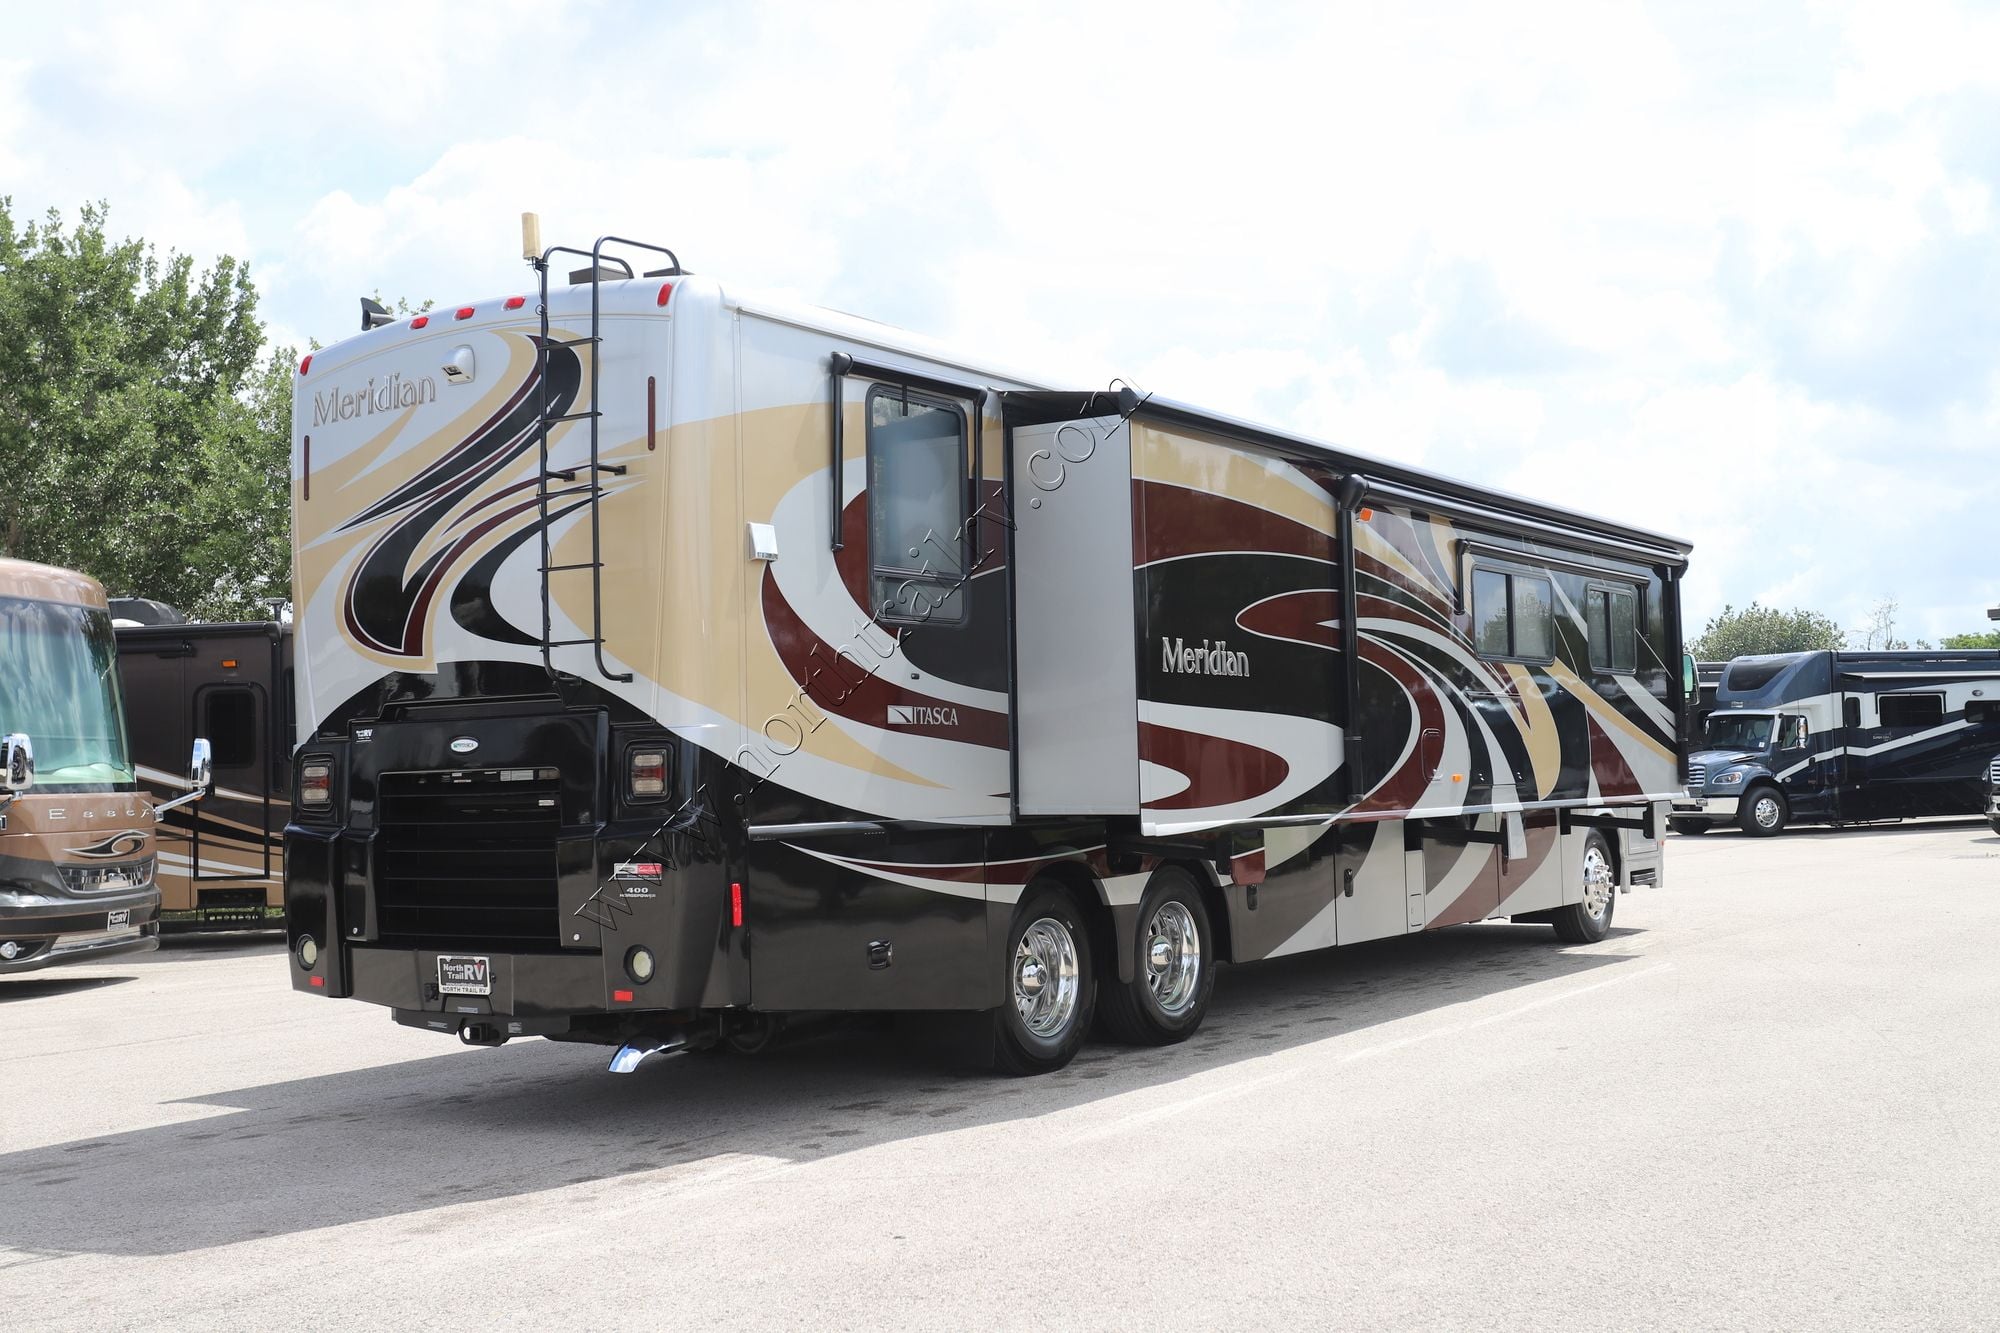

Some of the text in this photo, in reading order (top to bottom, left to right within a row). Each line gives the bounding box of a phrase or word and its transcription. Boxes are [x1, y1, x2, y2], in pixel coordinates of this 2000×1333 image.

[313, 372, 436, 427] Meridian
[1162, 636, 1250, 677] Meridian
[914, 706, 959, 726] ITASCA
[443, 963, 485, 980] North RV
[447, 971, 464, 980] Trail
